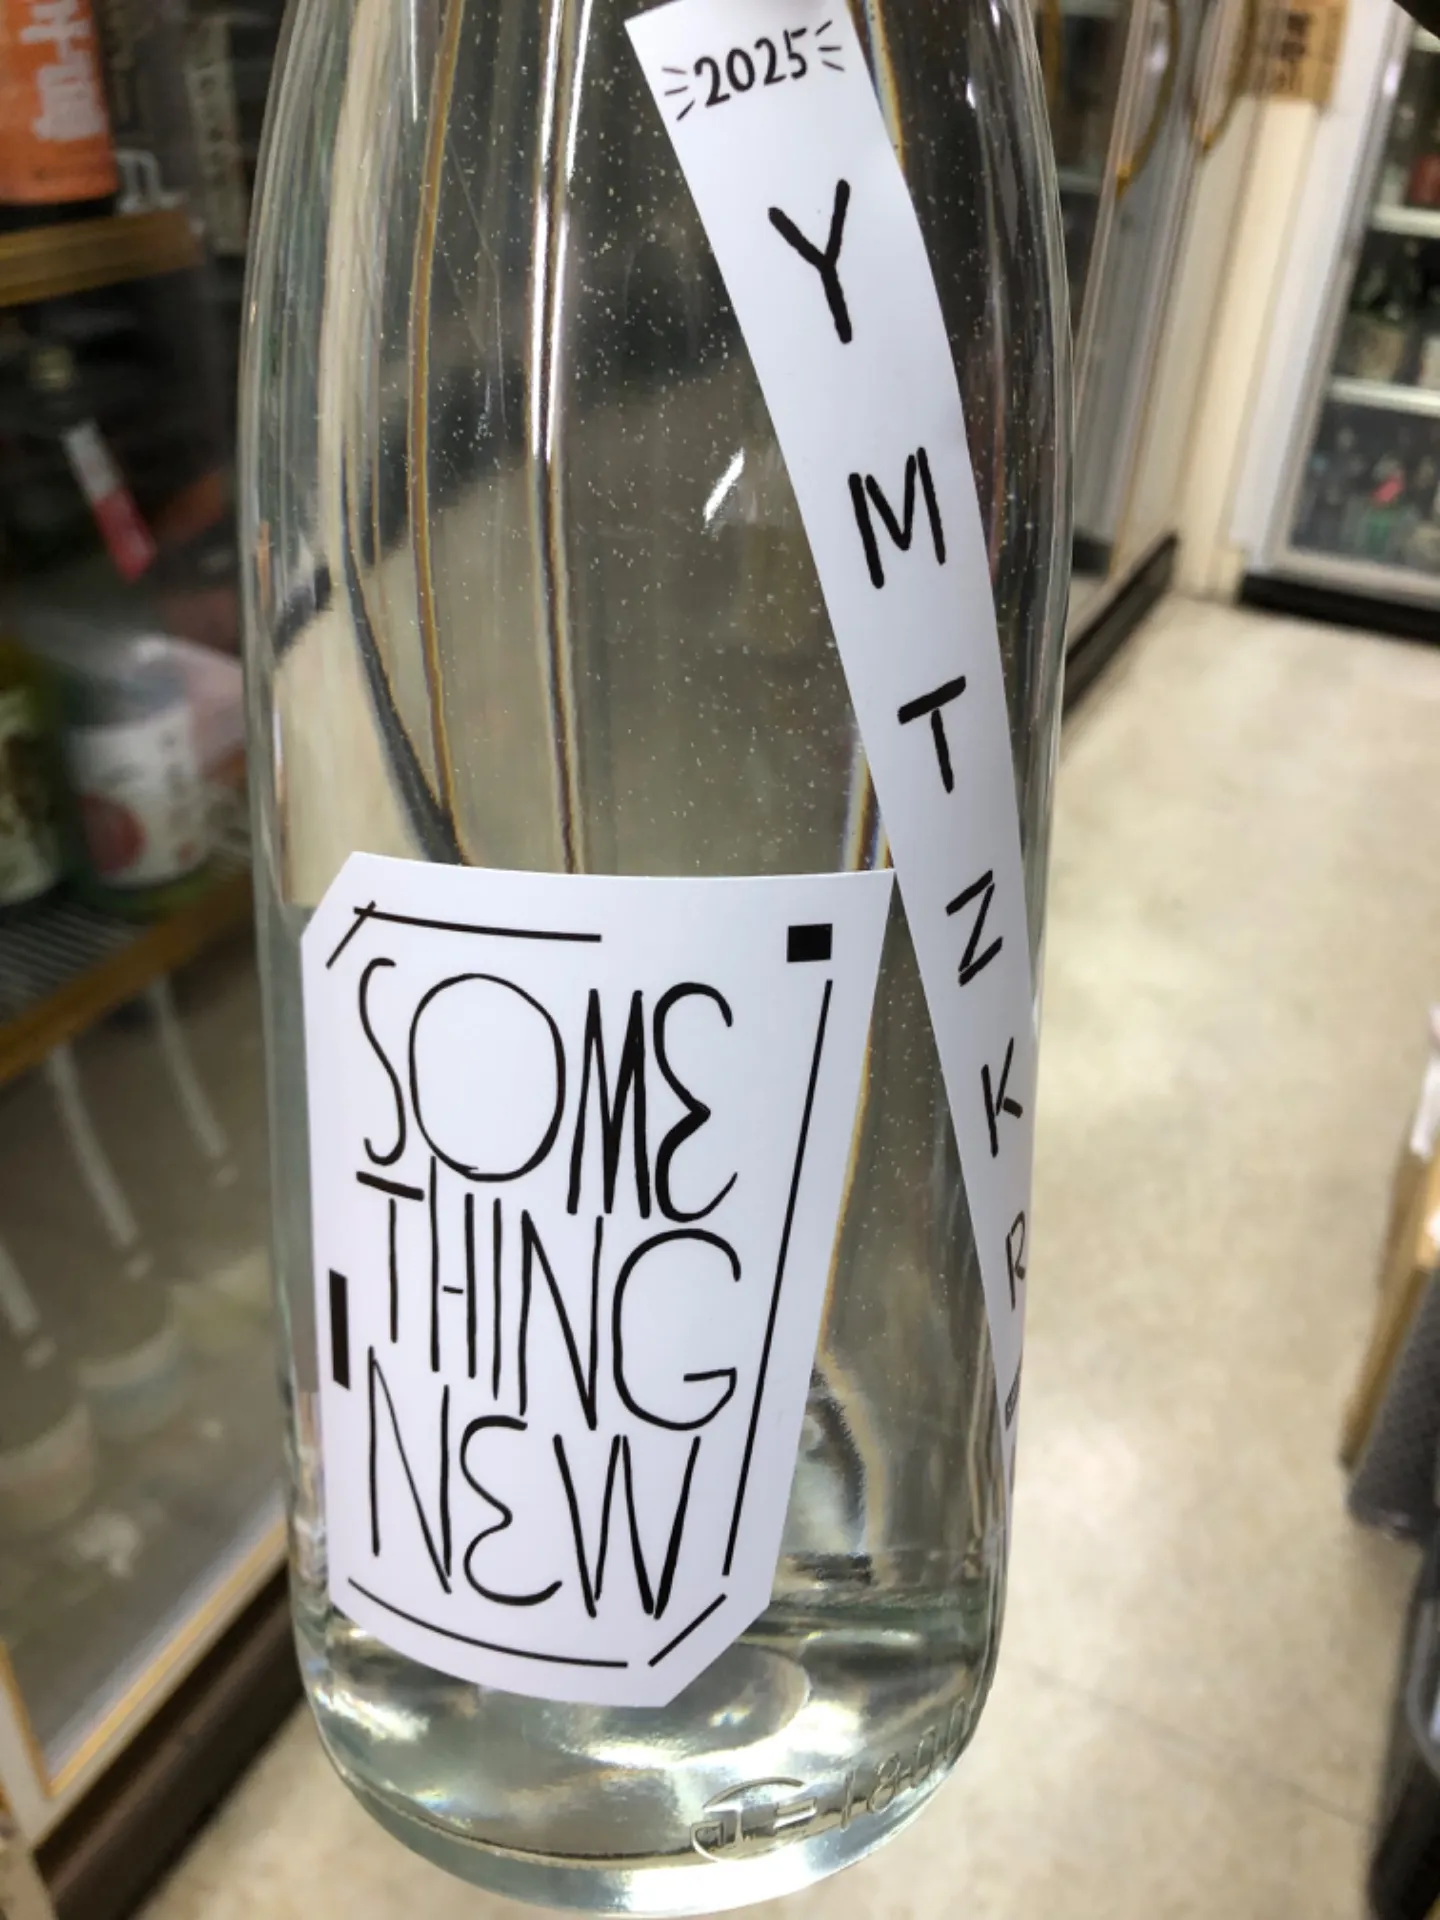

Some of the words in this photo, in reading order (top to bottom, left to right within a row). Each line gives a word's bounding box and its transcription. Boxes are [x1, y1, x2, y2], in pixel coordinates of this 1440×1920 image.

[693, 27, 809, 109] 2025
[358, 957, 738, 1224] SOME
[356, 1155, 742, 1432] THING
[368, 1346, 702, 1621] NEW
